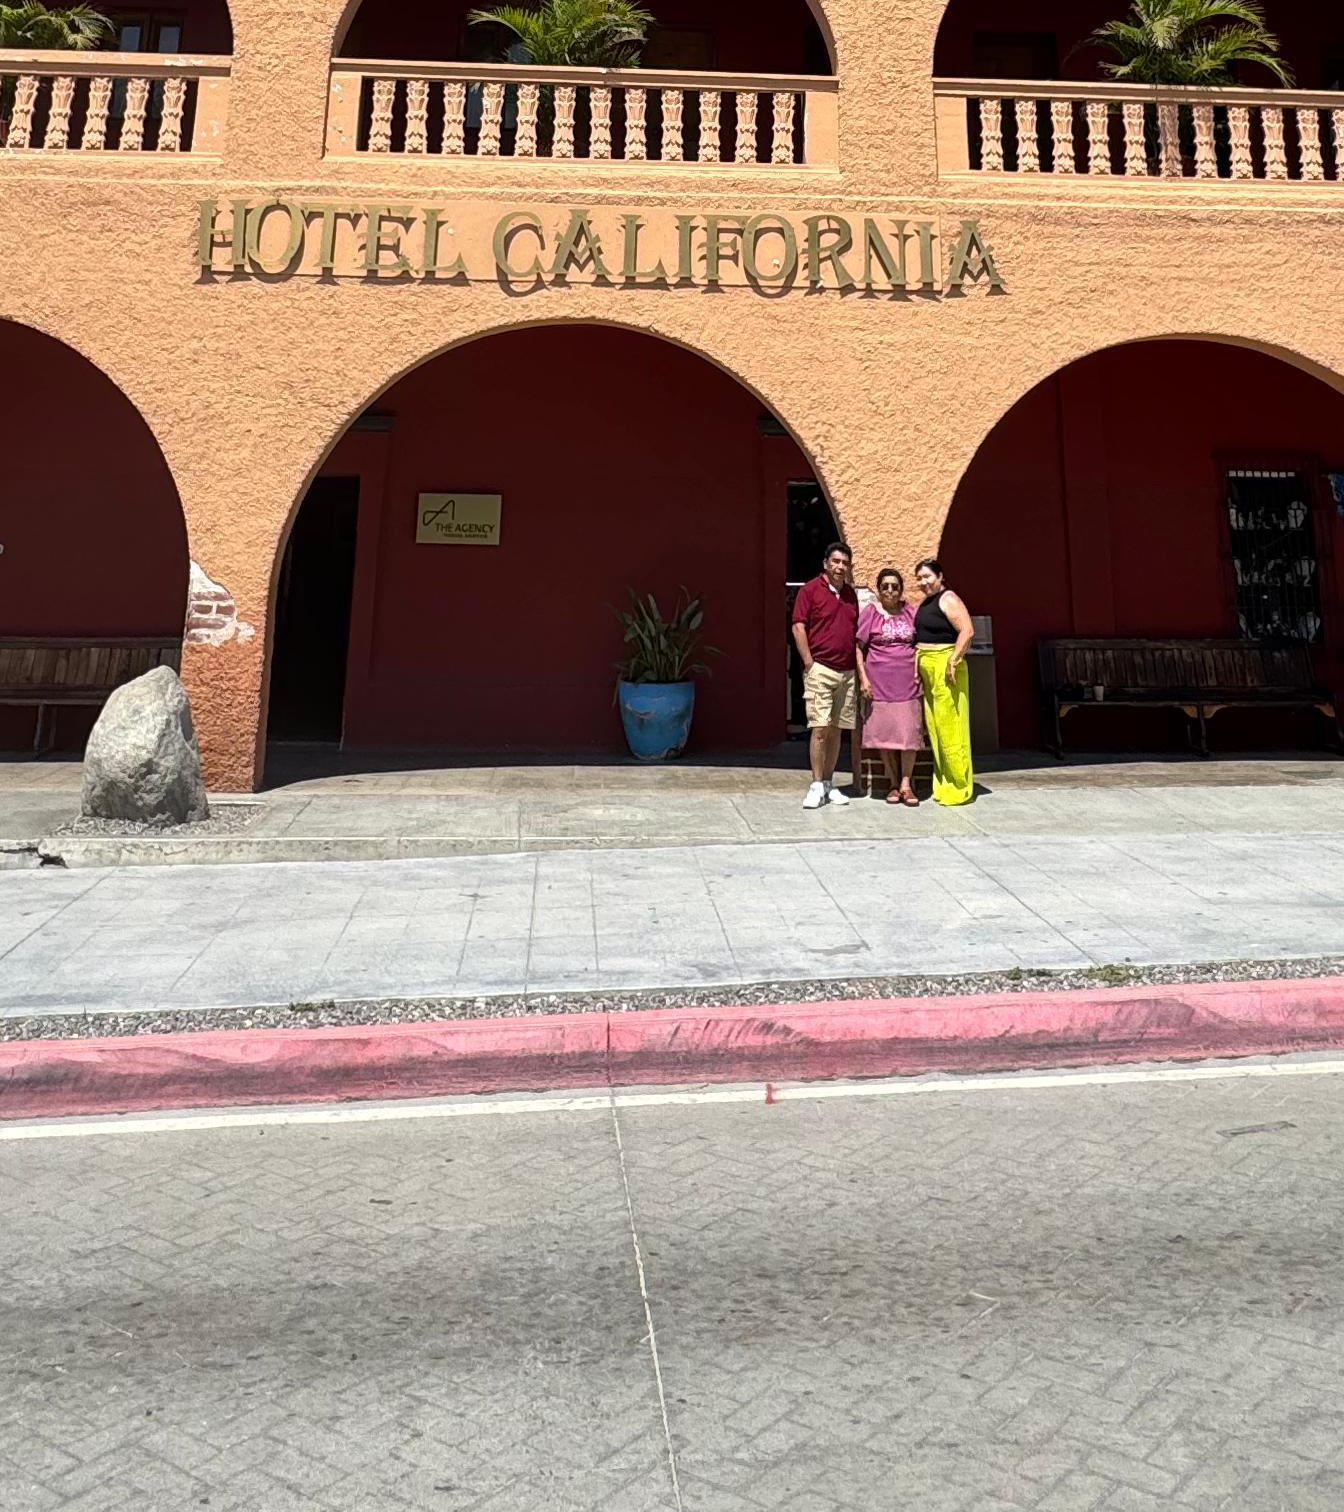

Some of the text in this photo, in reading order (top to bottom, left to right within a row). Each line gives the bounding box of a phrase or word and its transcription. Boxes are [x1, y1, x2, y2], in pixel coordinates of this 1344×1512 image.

[195, 199, 1006, 285] HOTEL CALIFORNIA
[435, 523, 496, 534] THE AGENCY
